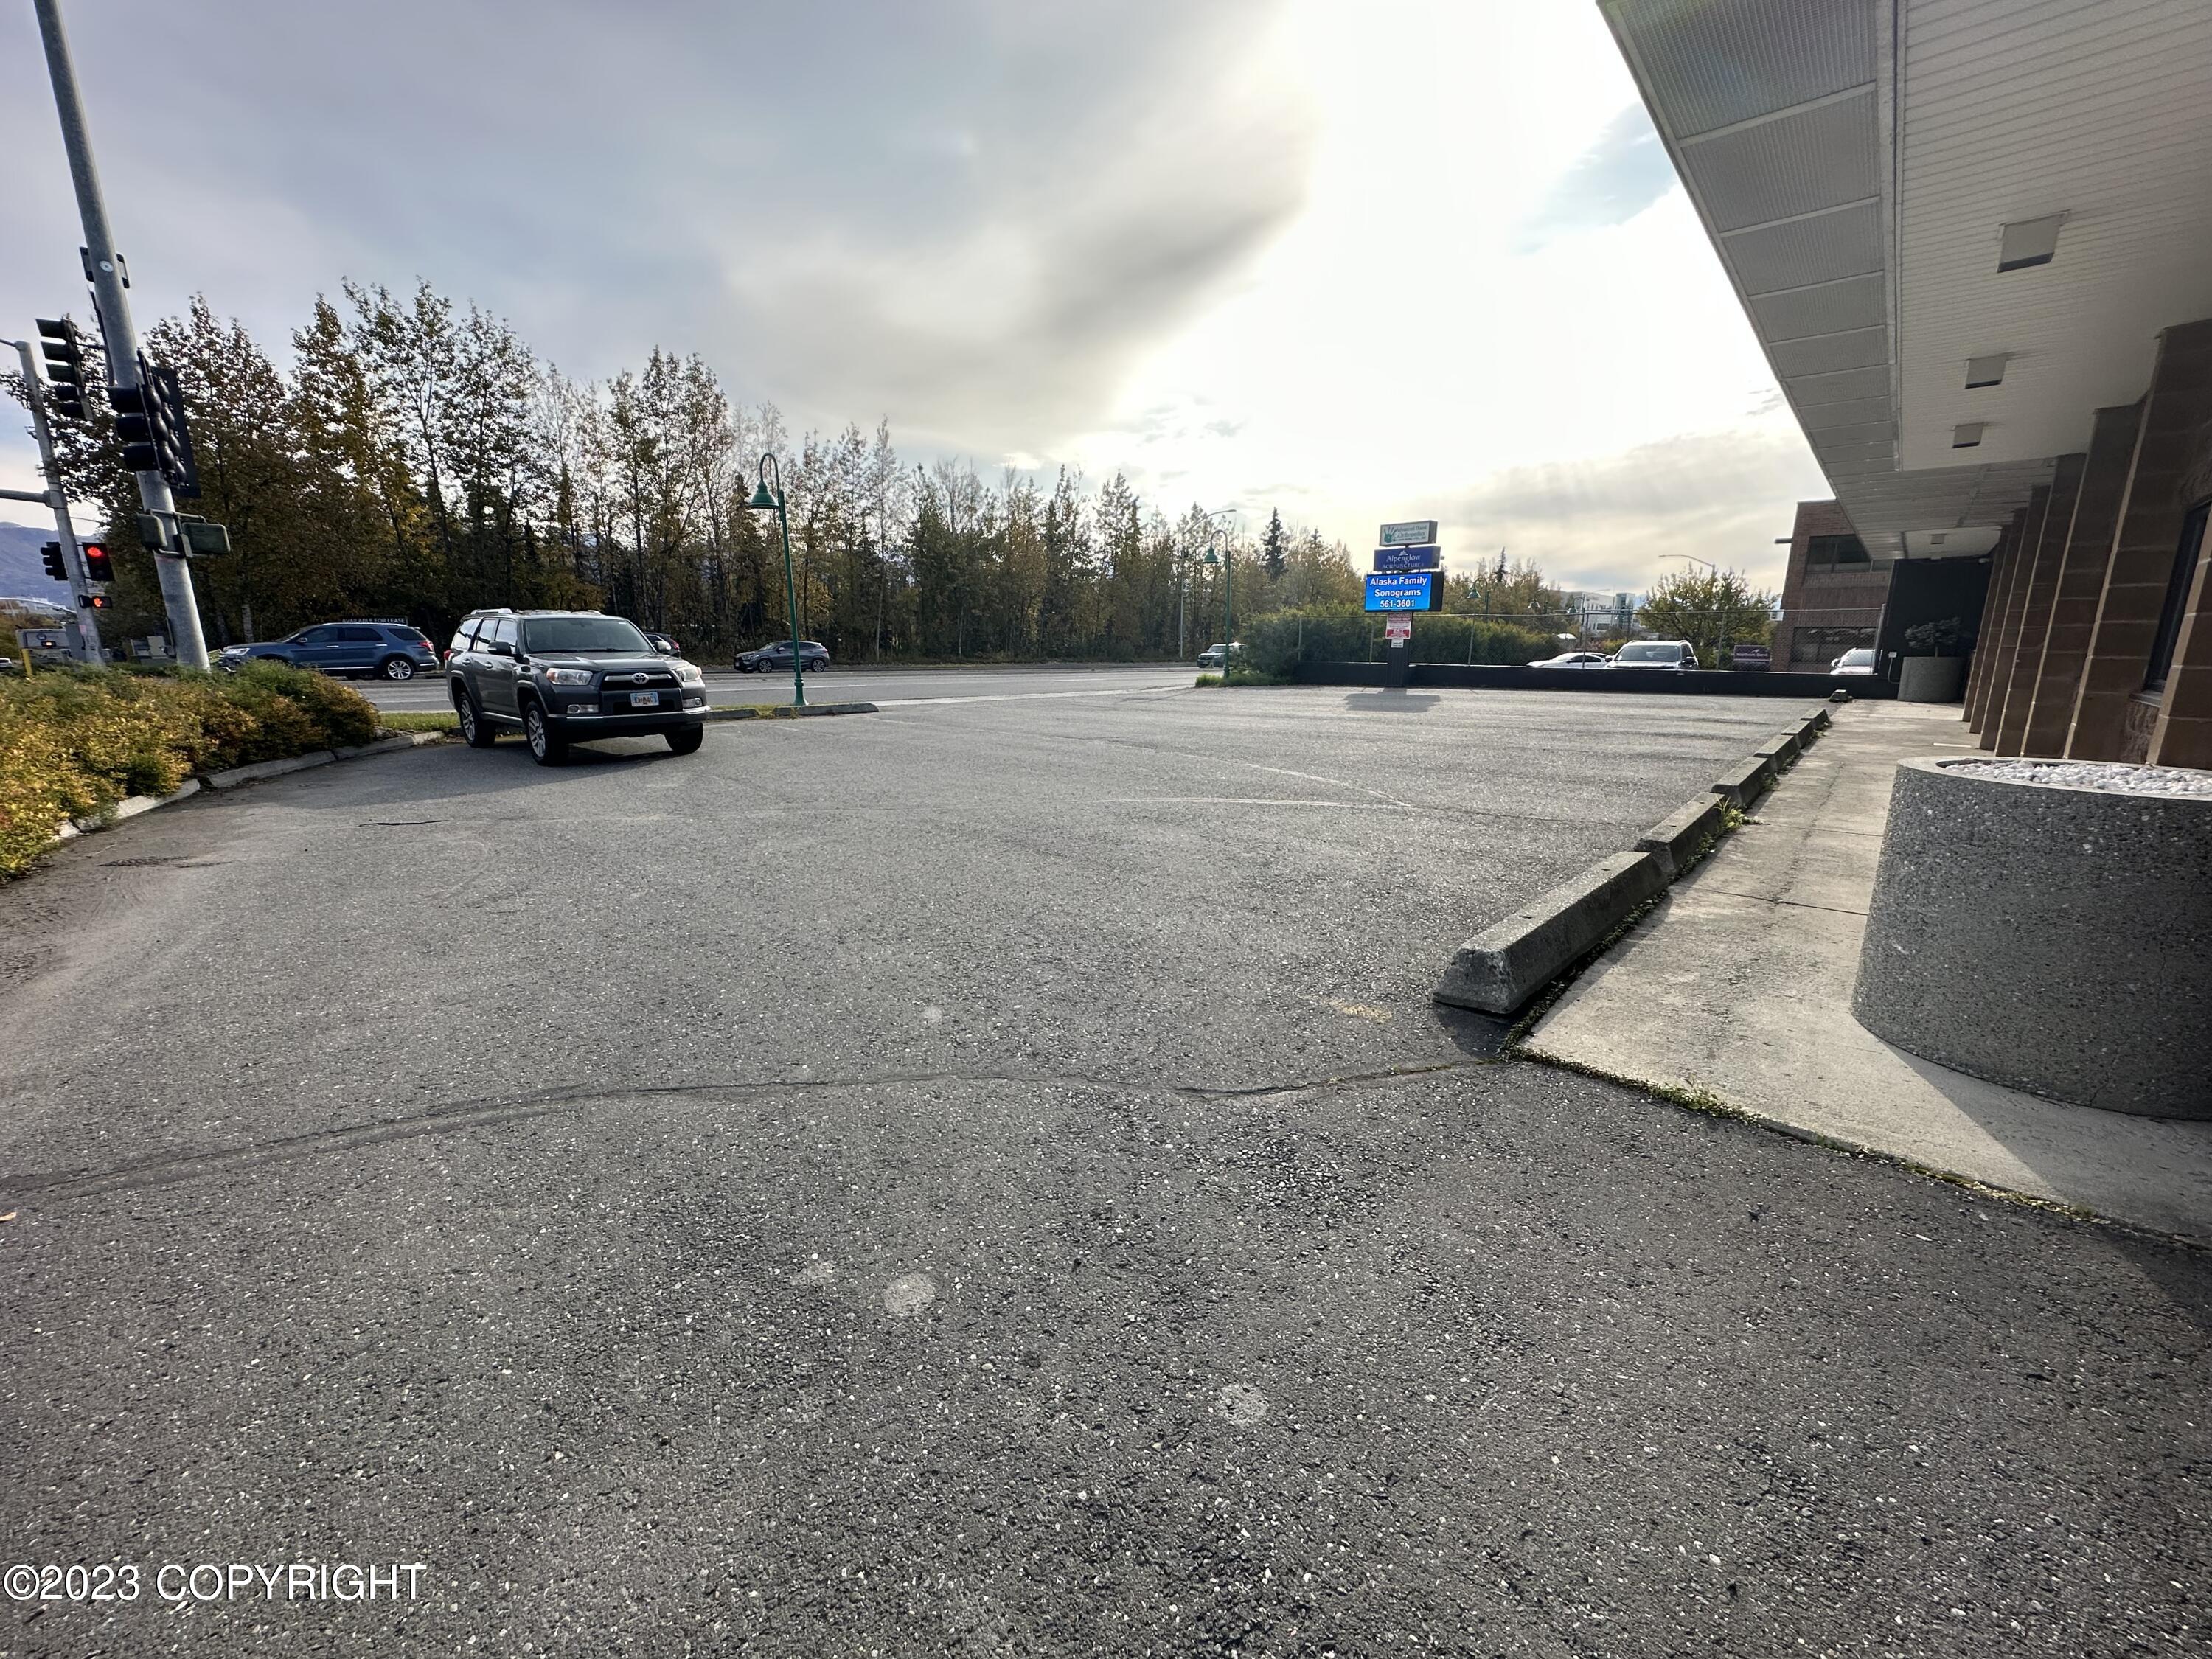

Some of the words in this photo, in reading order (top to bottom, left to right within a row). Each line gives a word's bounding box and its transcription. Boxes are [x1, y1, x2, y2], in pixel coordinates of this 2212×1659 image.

[1386, 554, 1421, 564] Alpenglow
[1370, 577, 1397, 586] Alaska
[1399, 576, 1427, 586] Family
[1374, 588, 1422, 598] Sonograms
[1380, 599, 1415, 608] 561-3601
